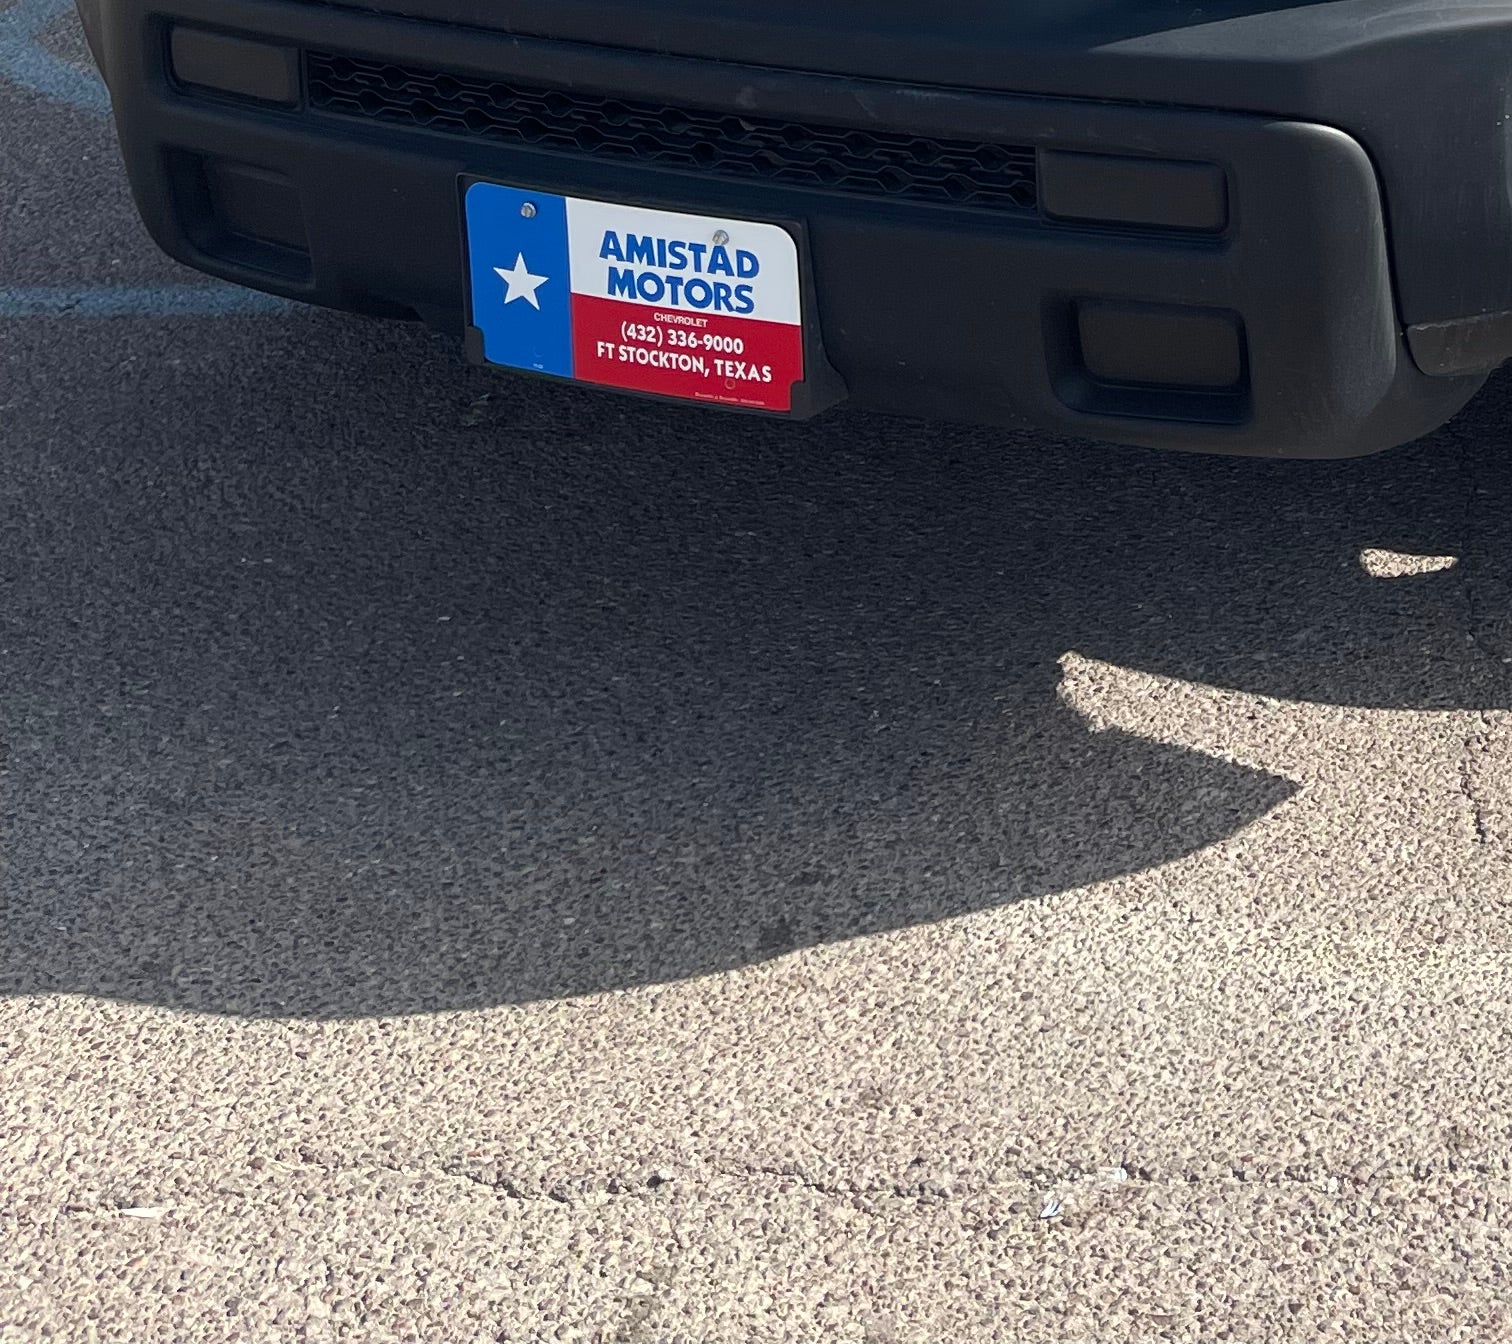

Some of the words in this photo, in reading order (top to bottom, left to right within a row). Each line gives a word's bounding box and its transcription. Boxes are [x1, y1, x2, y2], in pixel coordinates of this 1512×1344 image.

[599, 230, 760, 279] AMISTAD
[607, 266, 755, 314] MOTORS
[621, 321, 663, 347] (432)
[667, 328, 744, 354] 336-9000
[653, 312, 708, 328] CHEVROLET
[597, 341, 615, 359] FT
[618, 344, 710, 377] STOCKTON,
[713, 360, 772, 382] TEXAS
